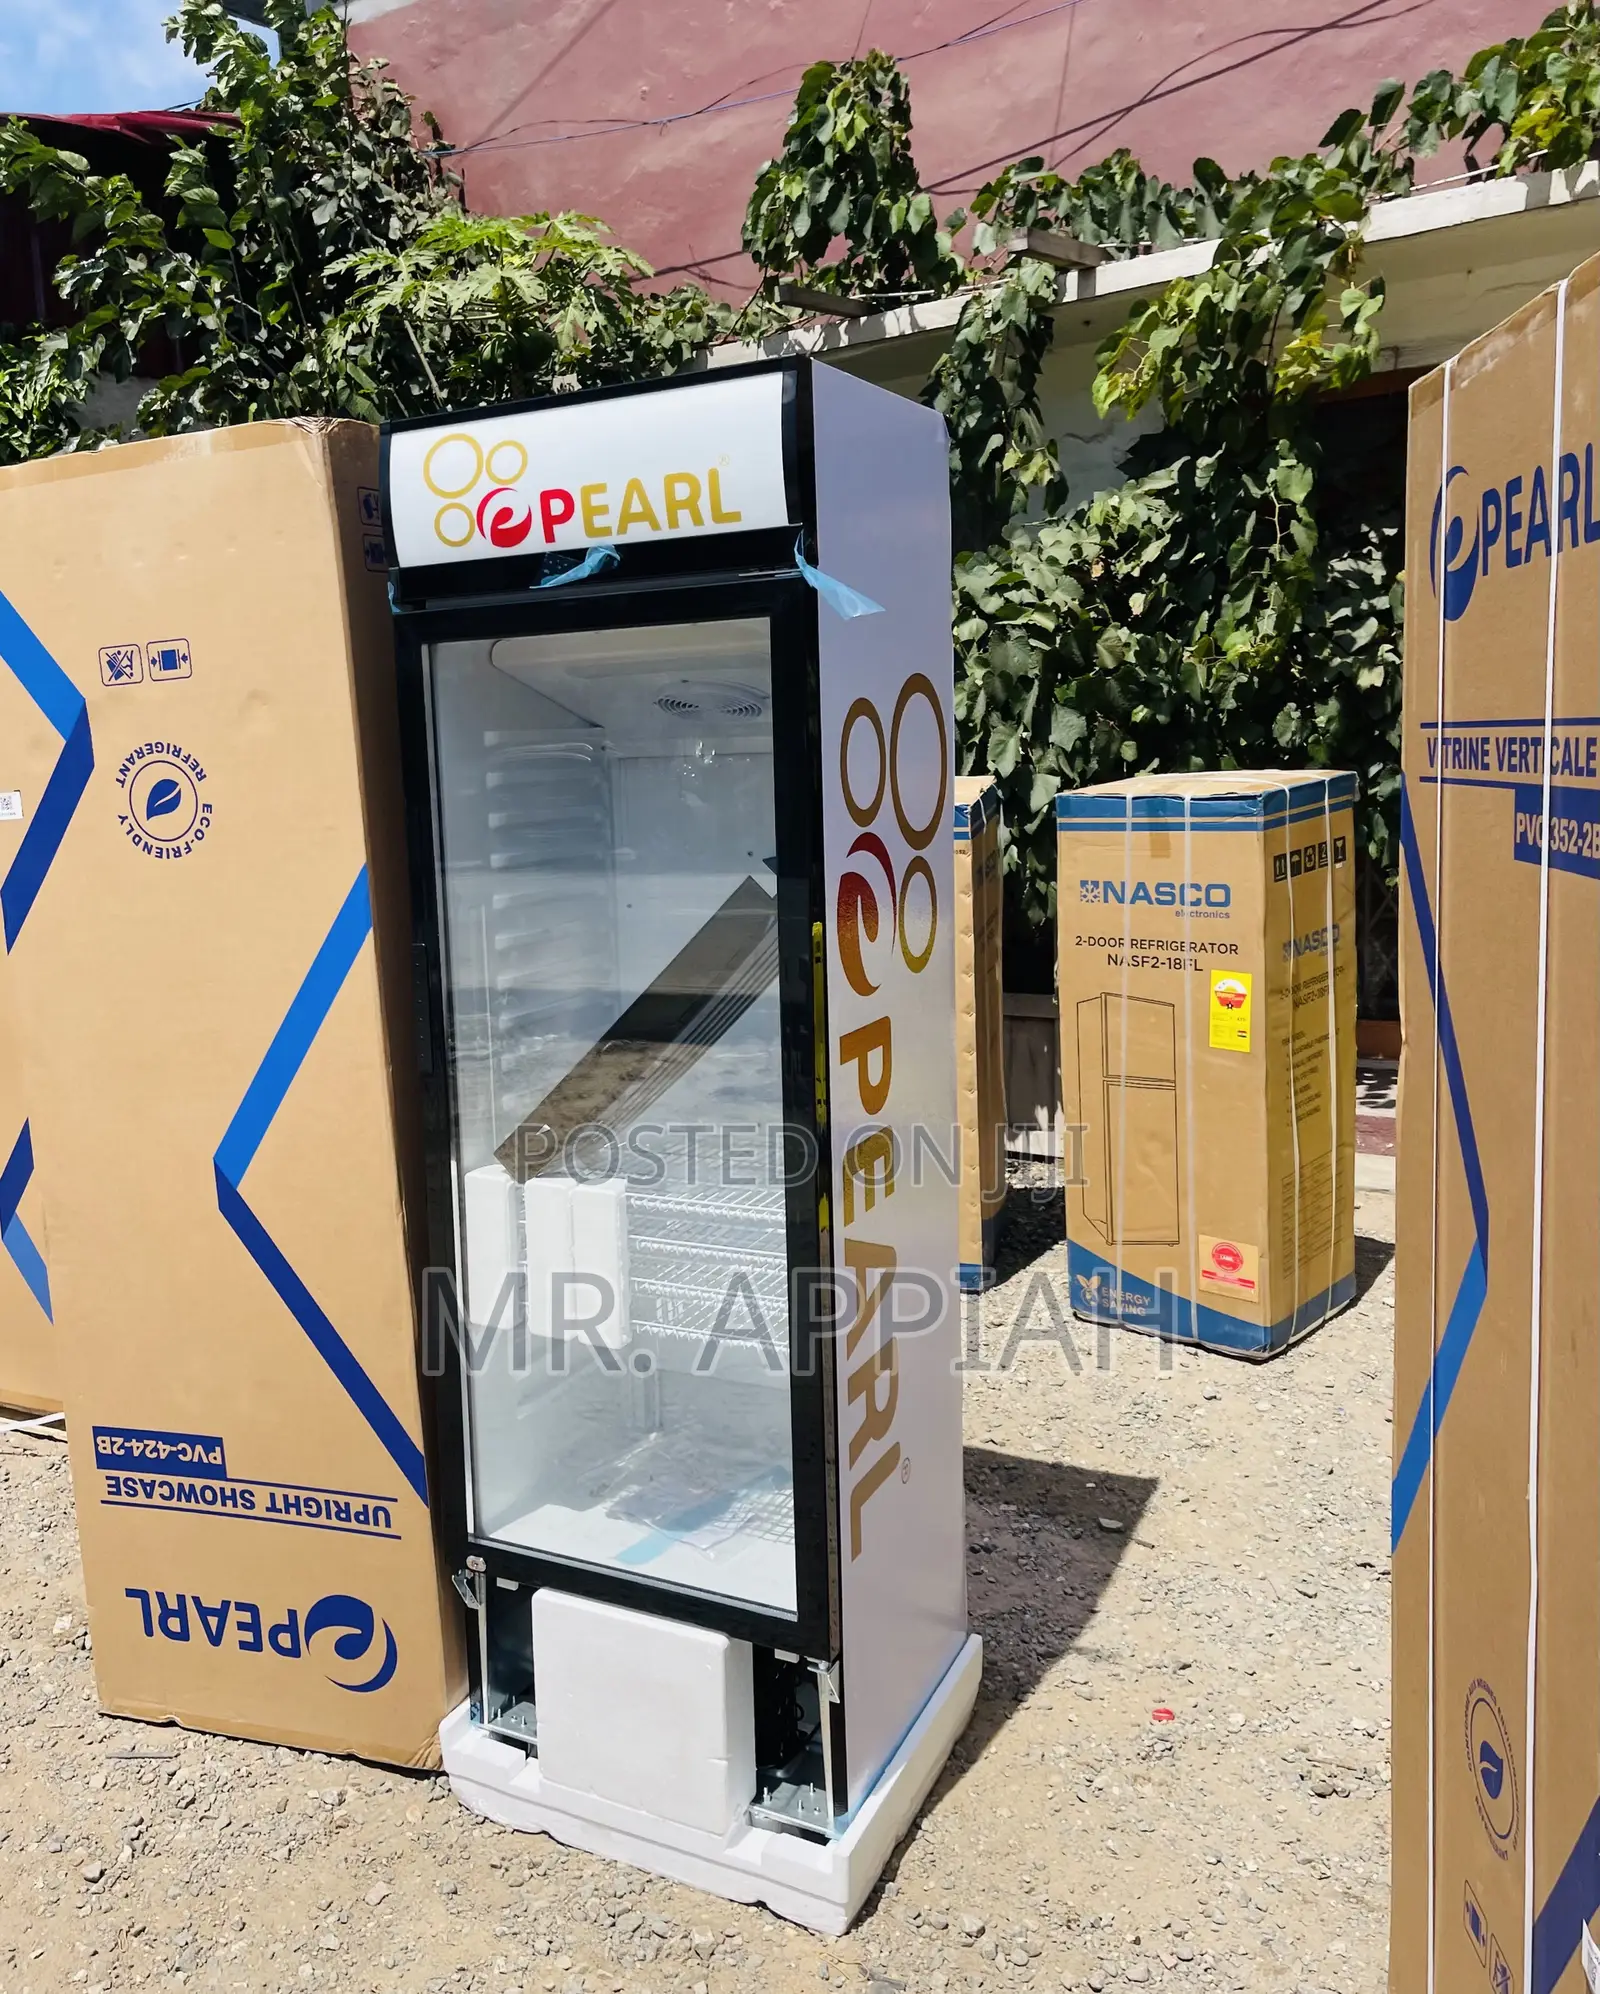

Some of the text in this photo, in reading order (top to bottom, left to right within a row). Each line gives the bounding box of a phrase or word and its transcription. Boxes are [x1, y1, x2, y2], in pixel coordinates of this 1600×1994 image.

[540, 467, 742, 544] PEARL
[1482, 442, 1600, 577] PEARL
[115, 741, 207, 788] REFRIGERANT
[1427, 736, 1490, 771] VTRINE
[117, 803, 213, 860] ECO-FRIENDLY
[1102, 881, 1231, 908] NASCO
[1131, 938, 1239, 955] REFRIGERATOR
[839, 1016, 901, 1563] PEARL
[96, 1435, 223, 1465] PVC-424-2B
[105, 1475, 393, 1529] UPRIGHT SHOWCASE
[125, 1587, 302, 1659] PEARL
